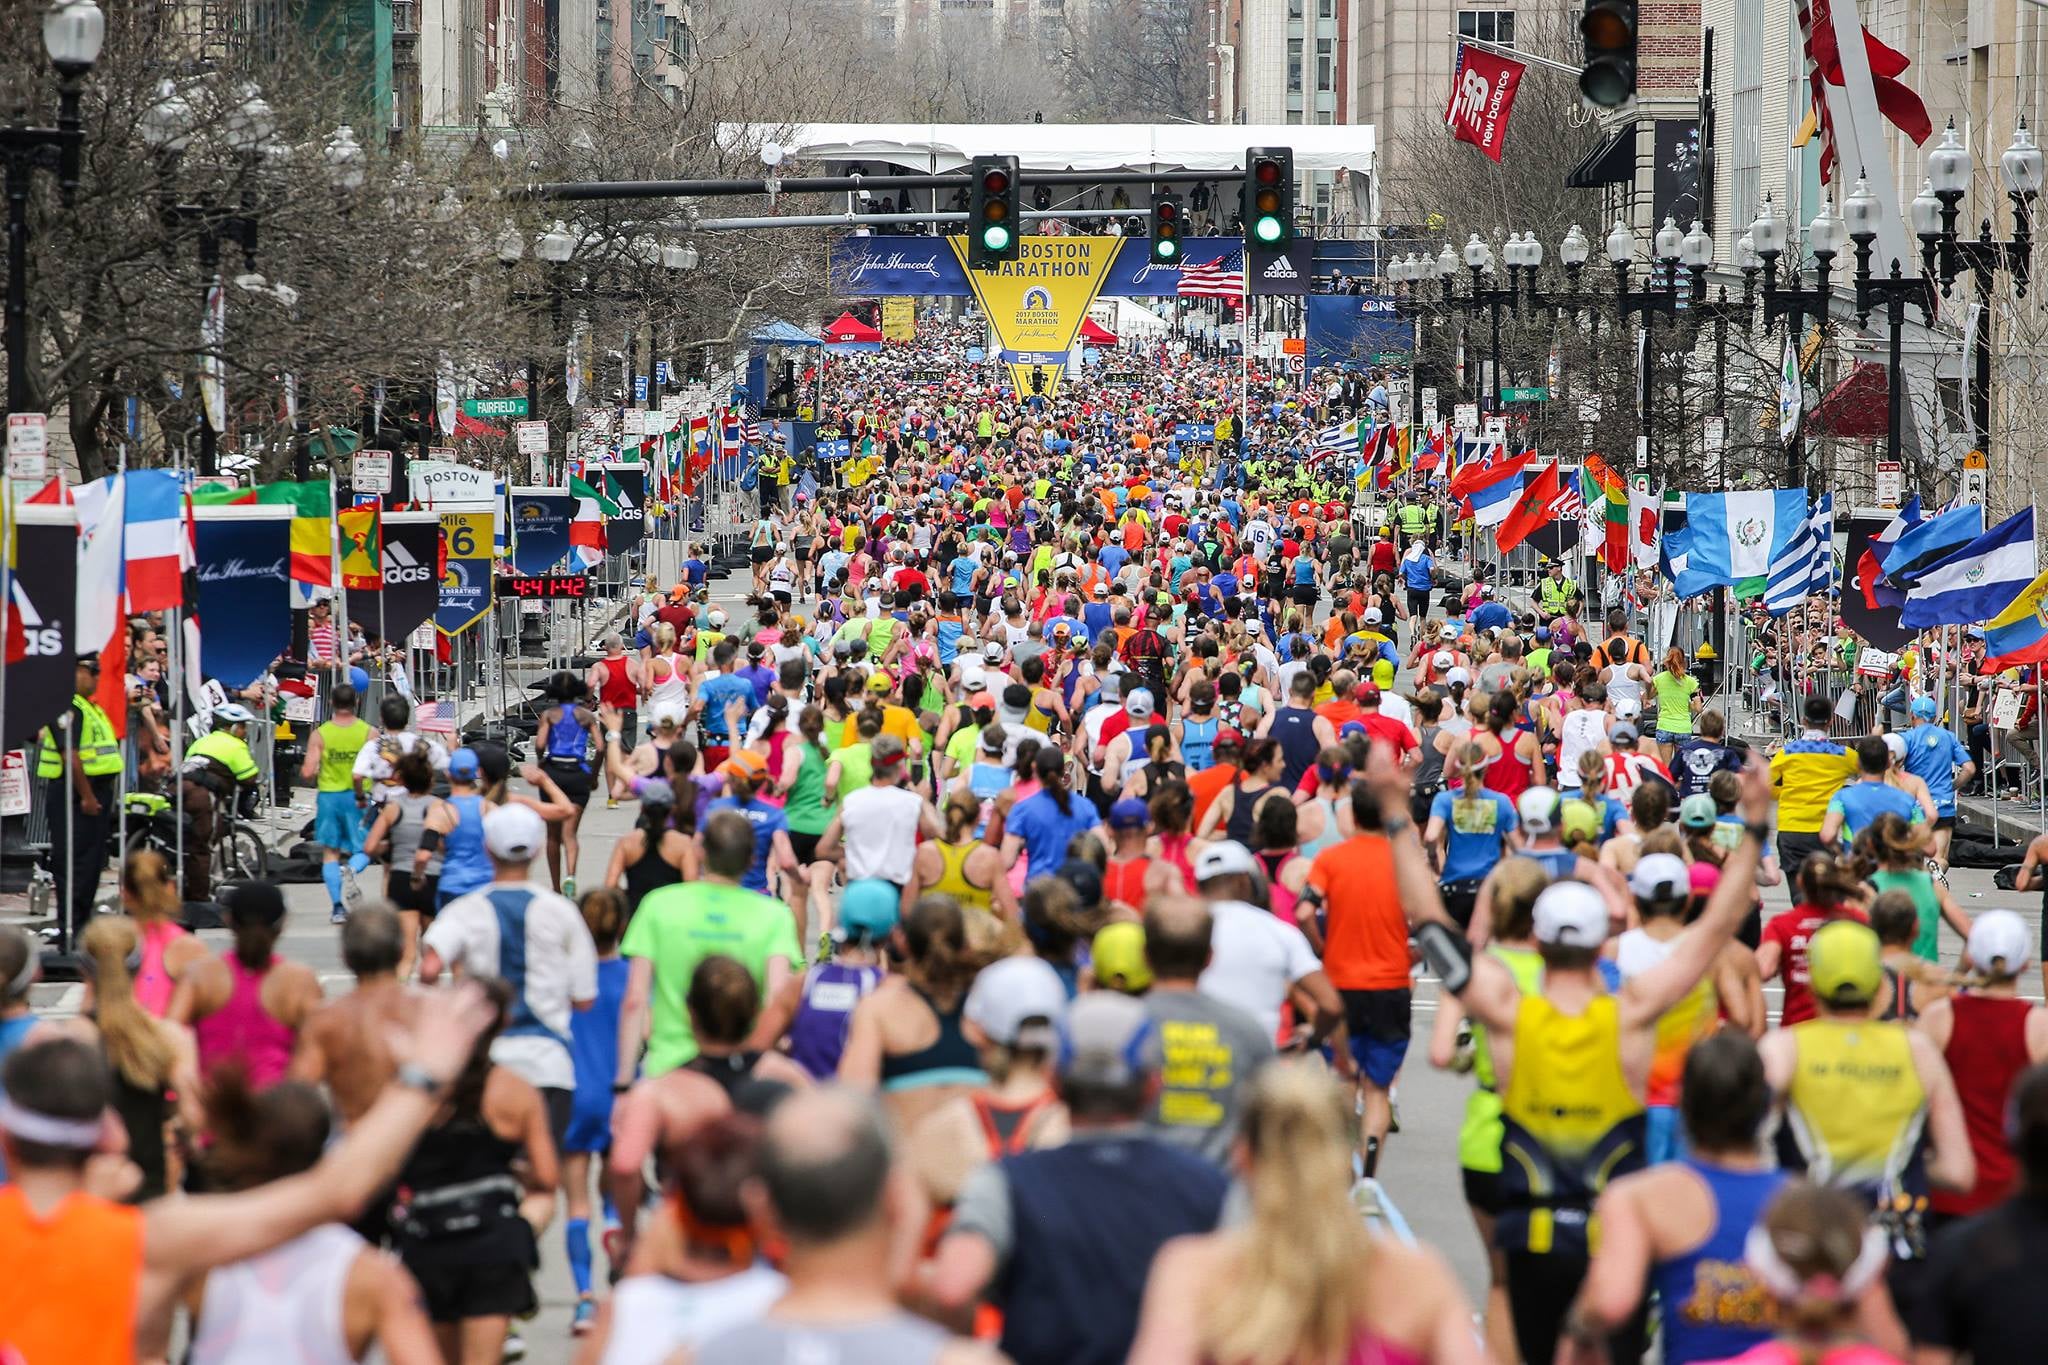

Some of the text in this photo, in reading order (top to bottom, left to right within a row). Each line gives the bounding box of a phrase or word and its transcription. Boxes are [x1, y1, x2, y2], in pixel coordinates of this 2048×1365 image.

[1482, 70, 1510, 147] new balance
[1020, 243, 1090, 259] BOSTON
[848, 252, 941, 282] John Hancock
[1263, 269, 1298, 279] adidas
[1514, 390, 1529, 400] RING
[477, 401, 516, 413] FAIRFIELD
[1190, 425, 1200, 440] 3
[827, 442, 836, 456] 3
[423, 471, 480, 485] BOSTON
[440, 513, 467, 526] Mile
[440, 527, 475, 556] 6
[1253, 530, 1265, 543] 16
[219, 557, 289, 582] Hancock
